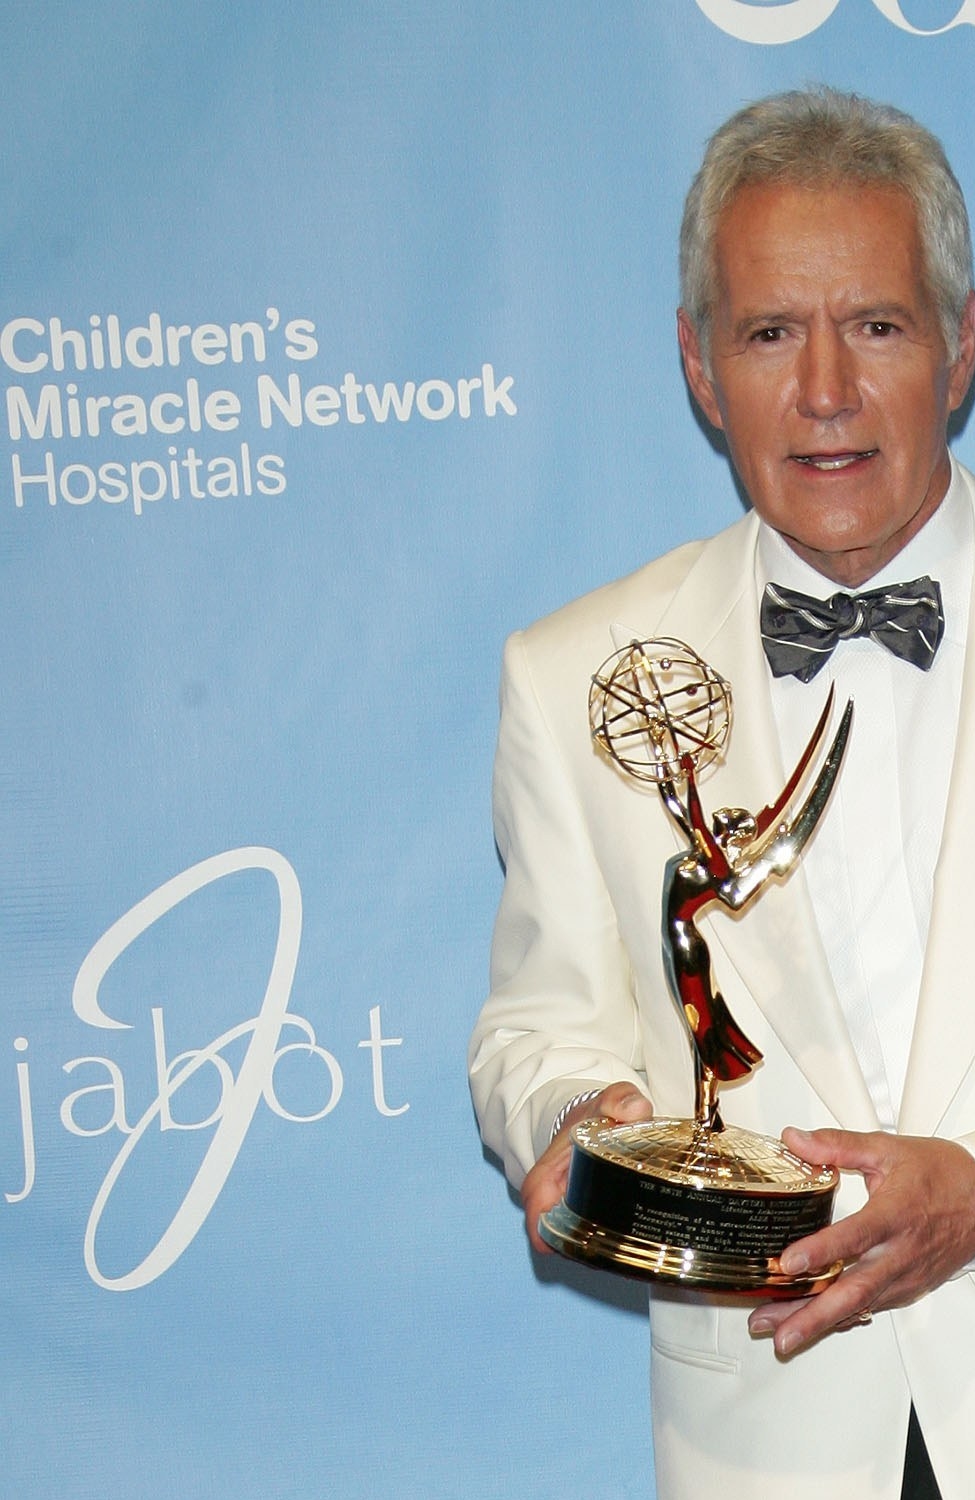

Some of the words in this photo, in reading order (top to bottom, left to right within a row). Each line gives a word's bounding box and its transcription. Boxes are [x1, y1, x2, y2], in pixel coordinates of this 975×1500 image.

[0, 306, 319, 374] Children's
[6, 377, 241, 441] Miracle
[257, 362, 518, 429] Network
[11, 442, 287, 516] Hospitals
[4, 1004, 411, 1203] jabot
